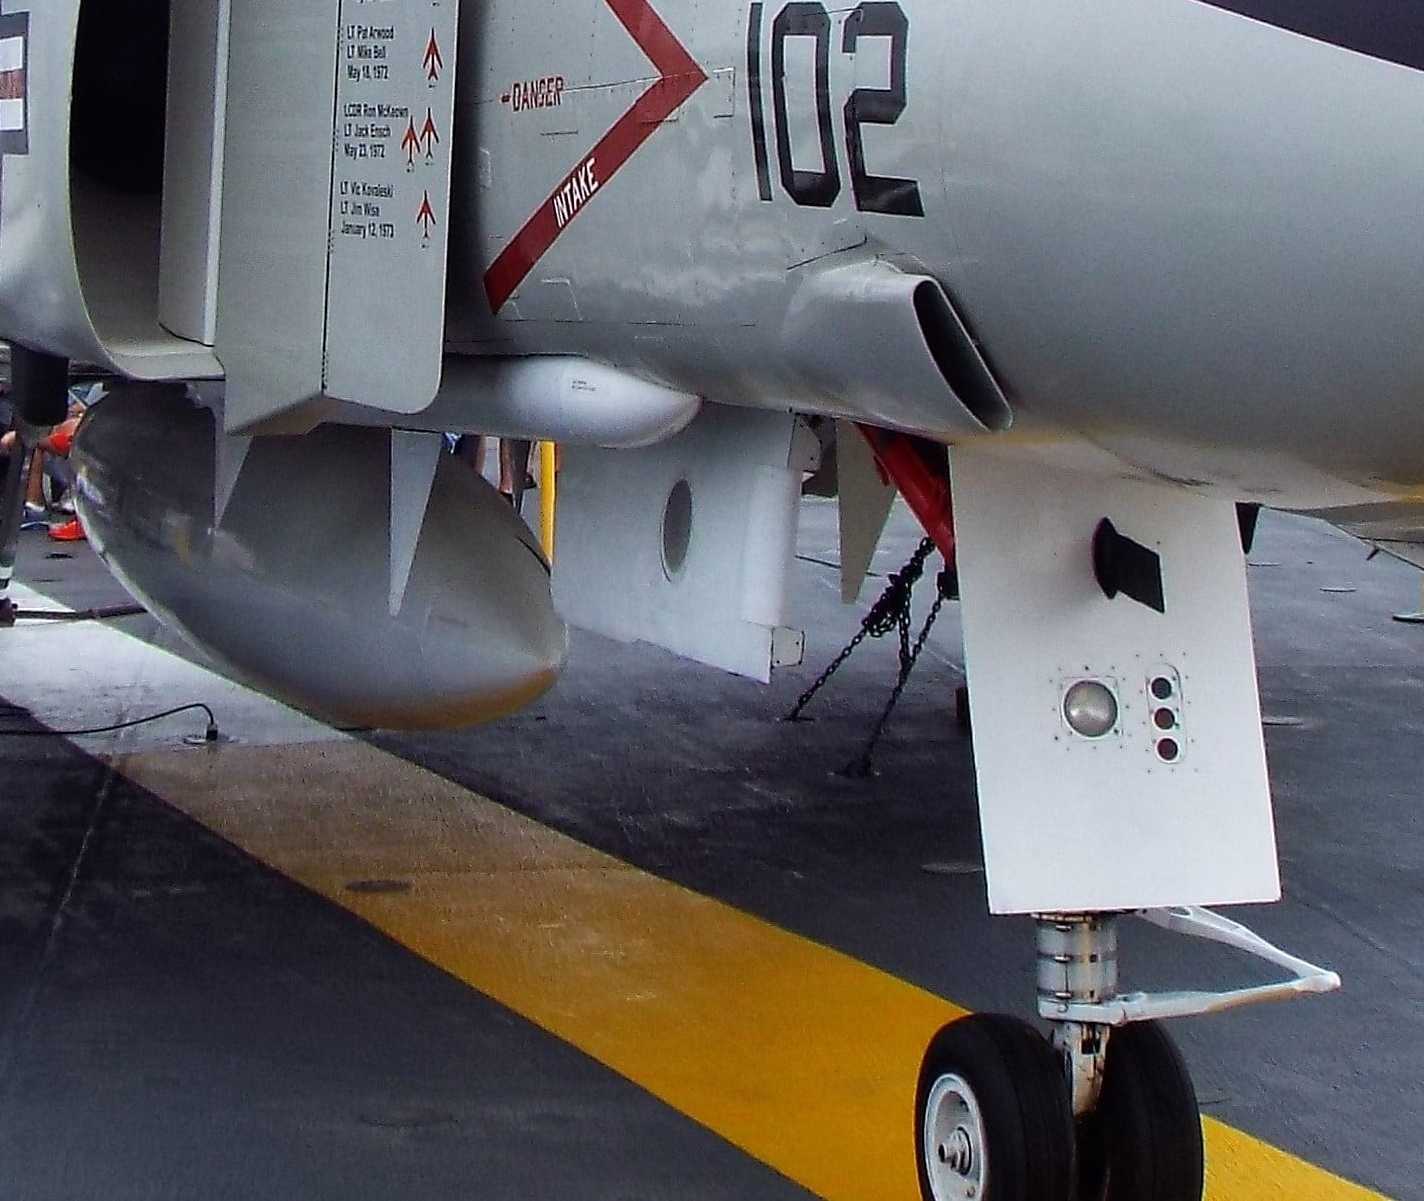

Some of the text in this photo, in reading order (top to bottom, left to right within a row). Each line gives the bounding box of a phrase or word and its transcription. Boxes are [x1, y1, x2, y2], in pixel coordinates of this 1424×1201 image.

[347, 27, 355, 39] LT
[347, 46, 355, 59] LT
[348, 65, 361, 82] May
[512, 76, 564, 112] DANGER
[747, 1, 926, 218] 102
[344, 124, 352, 137] LT
[344, 144, 357, 160] May
[340, 181, 348, 195] LT
[553, 157, 599, 228] INTAKE
[340, 201, 348, 215] LT
